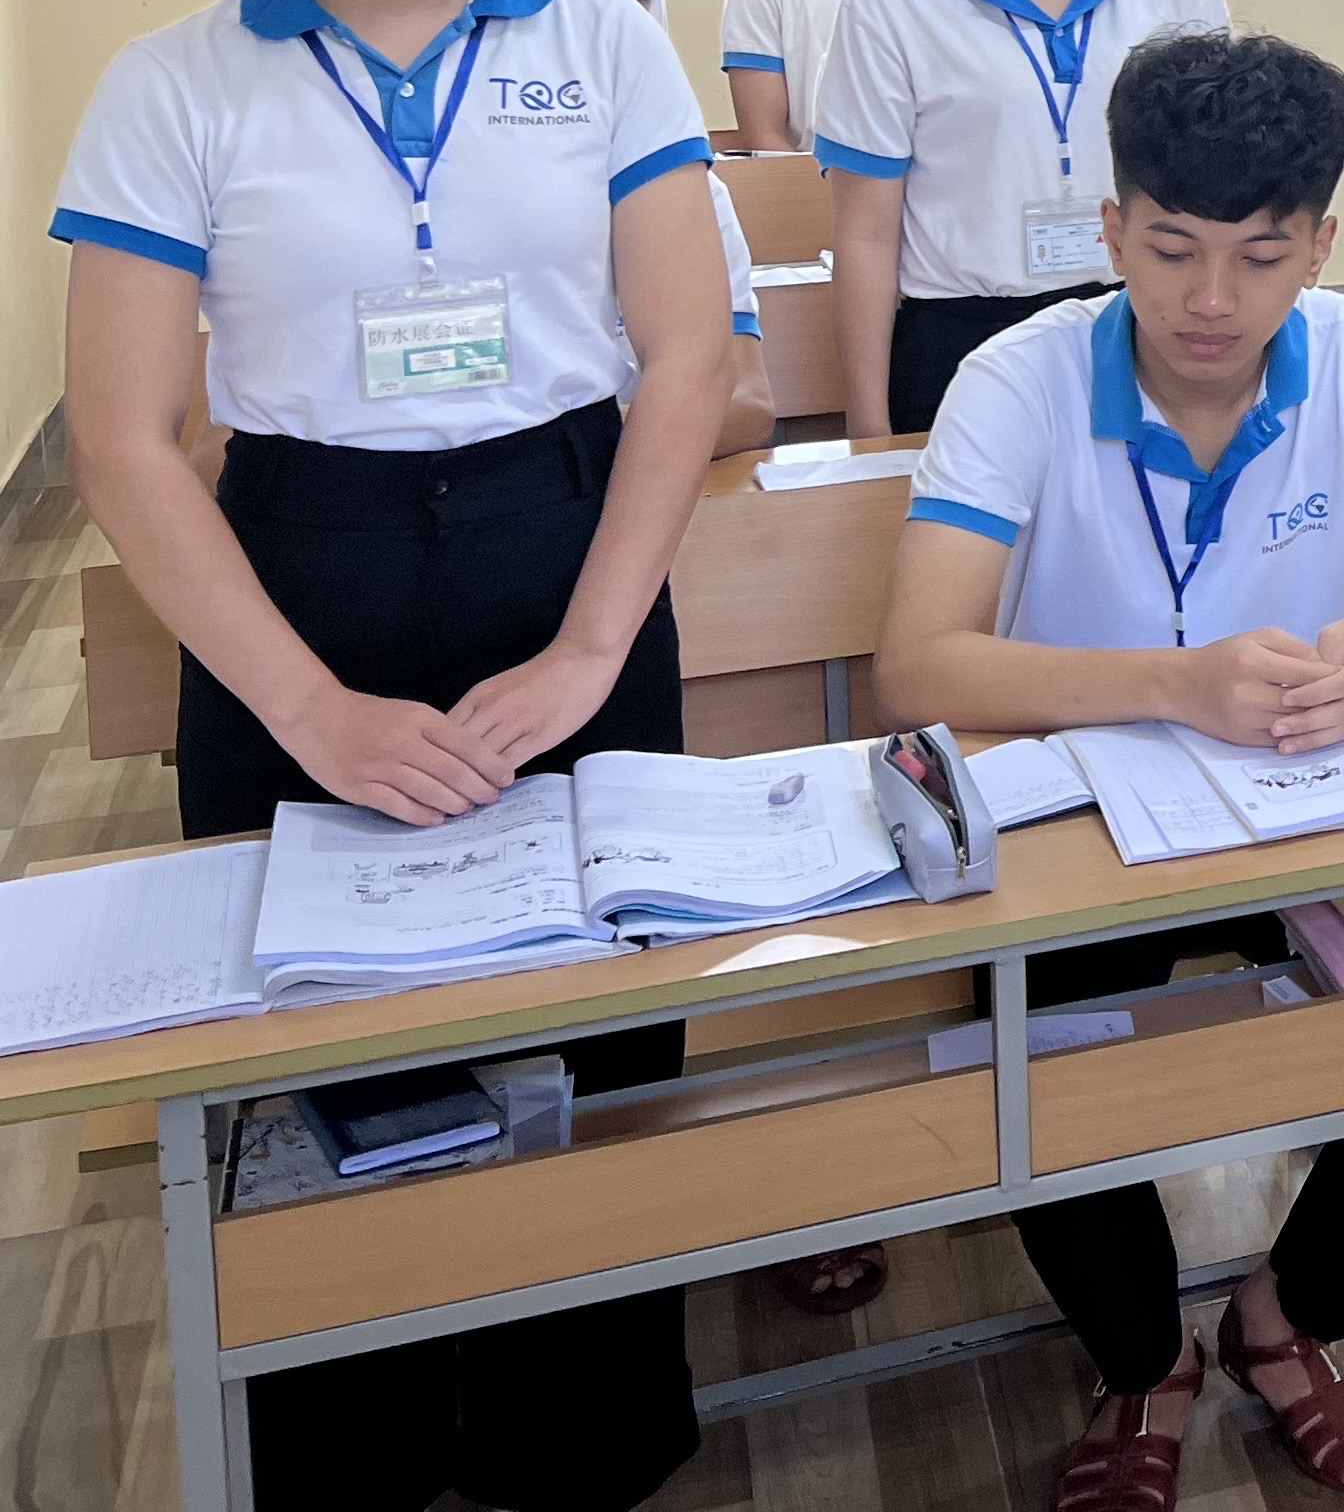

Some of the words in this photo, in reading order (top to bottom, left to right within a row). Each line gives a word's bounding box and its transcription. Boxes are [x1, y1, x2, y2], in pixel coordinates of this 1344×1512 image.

[488, 77, 587, 111] TQC
[487, 114, 592, 126] INTERNATIONAL
[1266, 492, 1329, 541] TQC
[1261, 522, 1329, 554] INTEONAL
